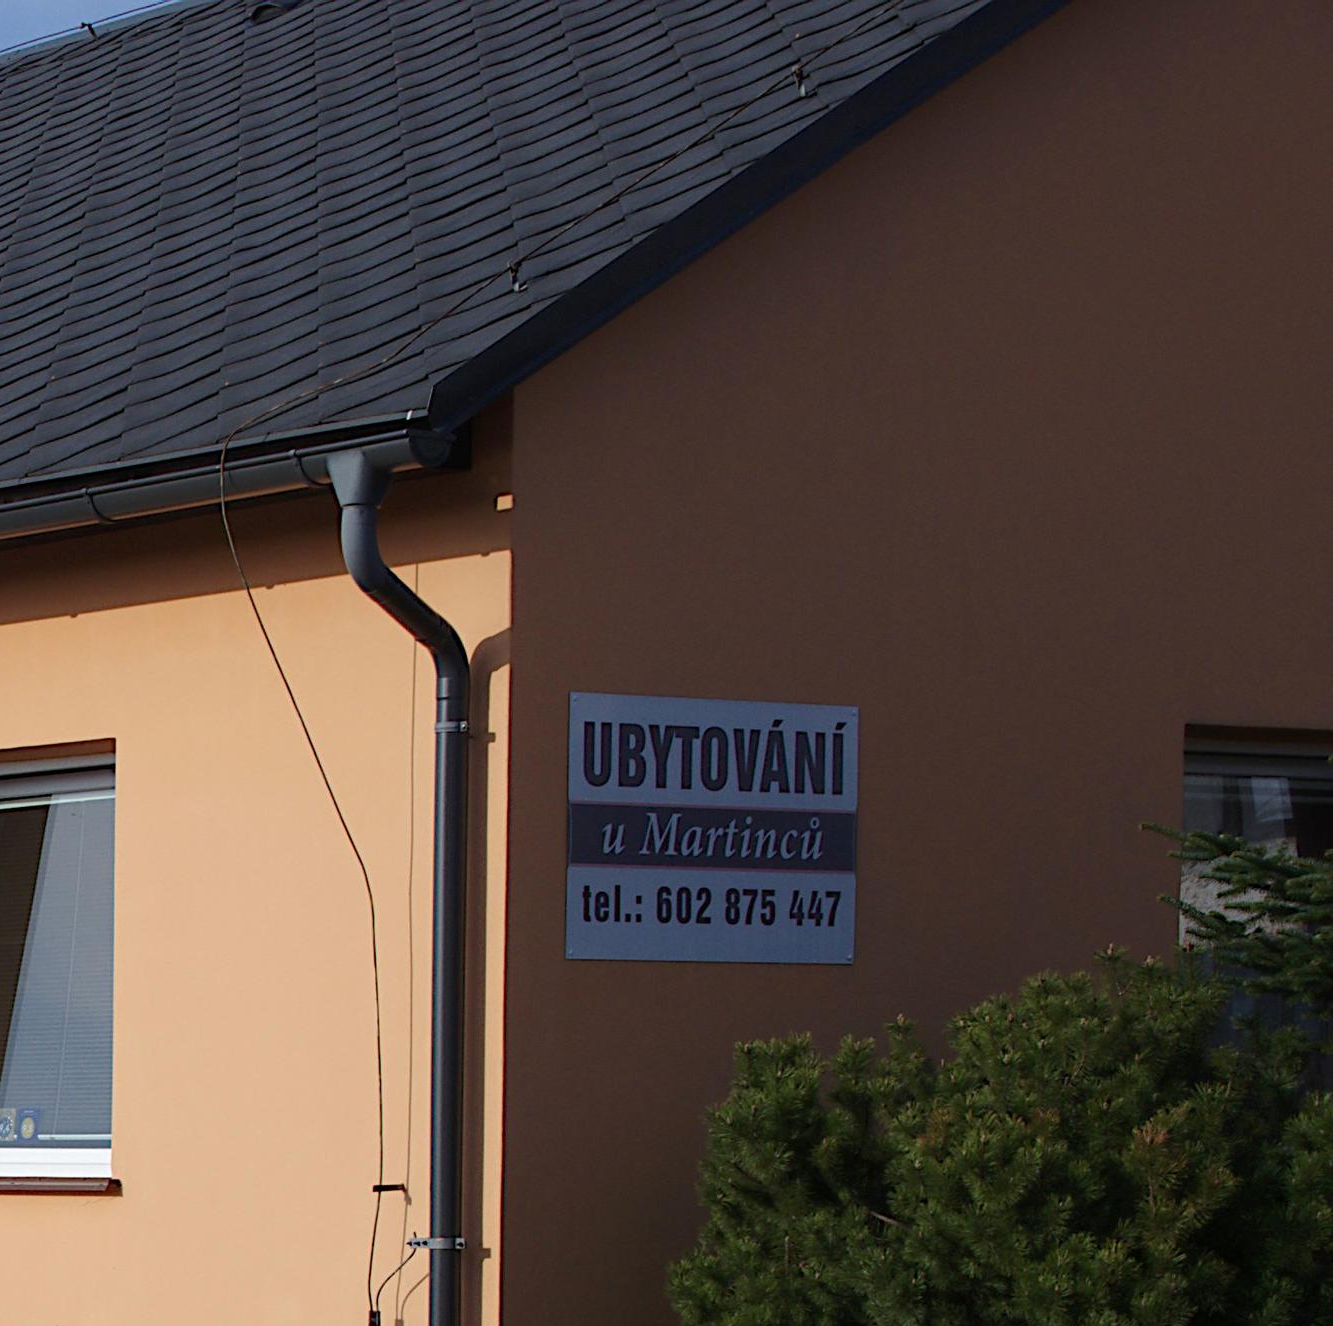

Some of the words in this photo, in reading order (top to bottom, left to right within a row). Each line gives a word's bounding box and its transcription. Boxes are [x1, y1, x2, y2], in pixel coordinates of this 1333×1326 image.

[582, 719, 847, 796] UBYTOVÁNÍ
[601, 821, 626, 856] u
[639, 812, 824, 861] Martinců
[582, 884, 643, 923] tel.:
[656, 886, 712, 925] 602
[725, 888, 776, 927] 875
[789, 890, 842, 928] 447
